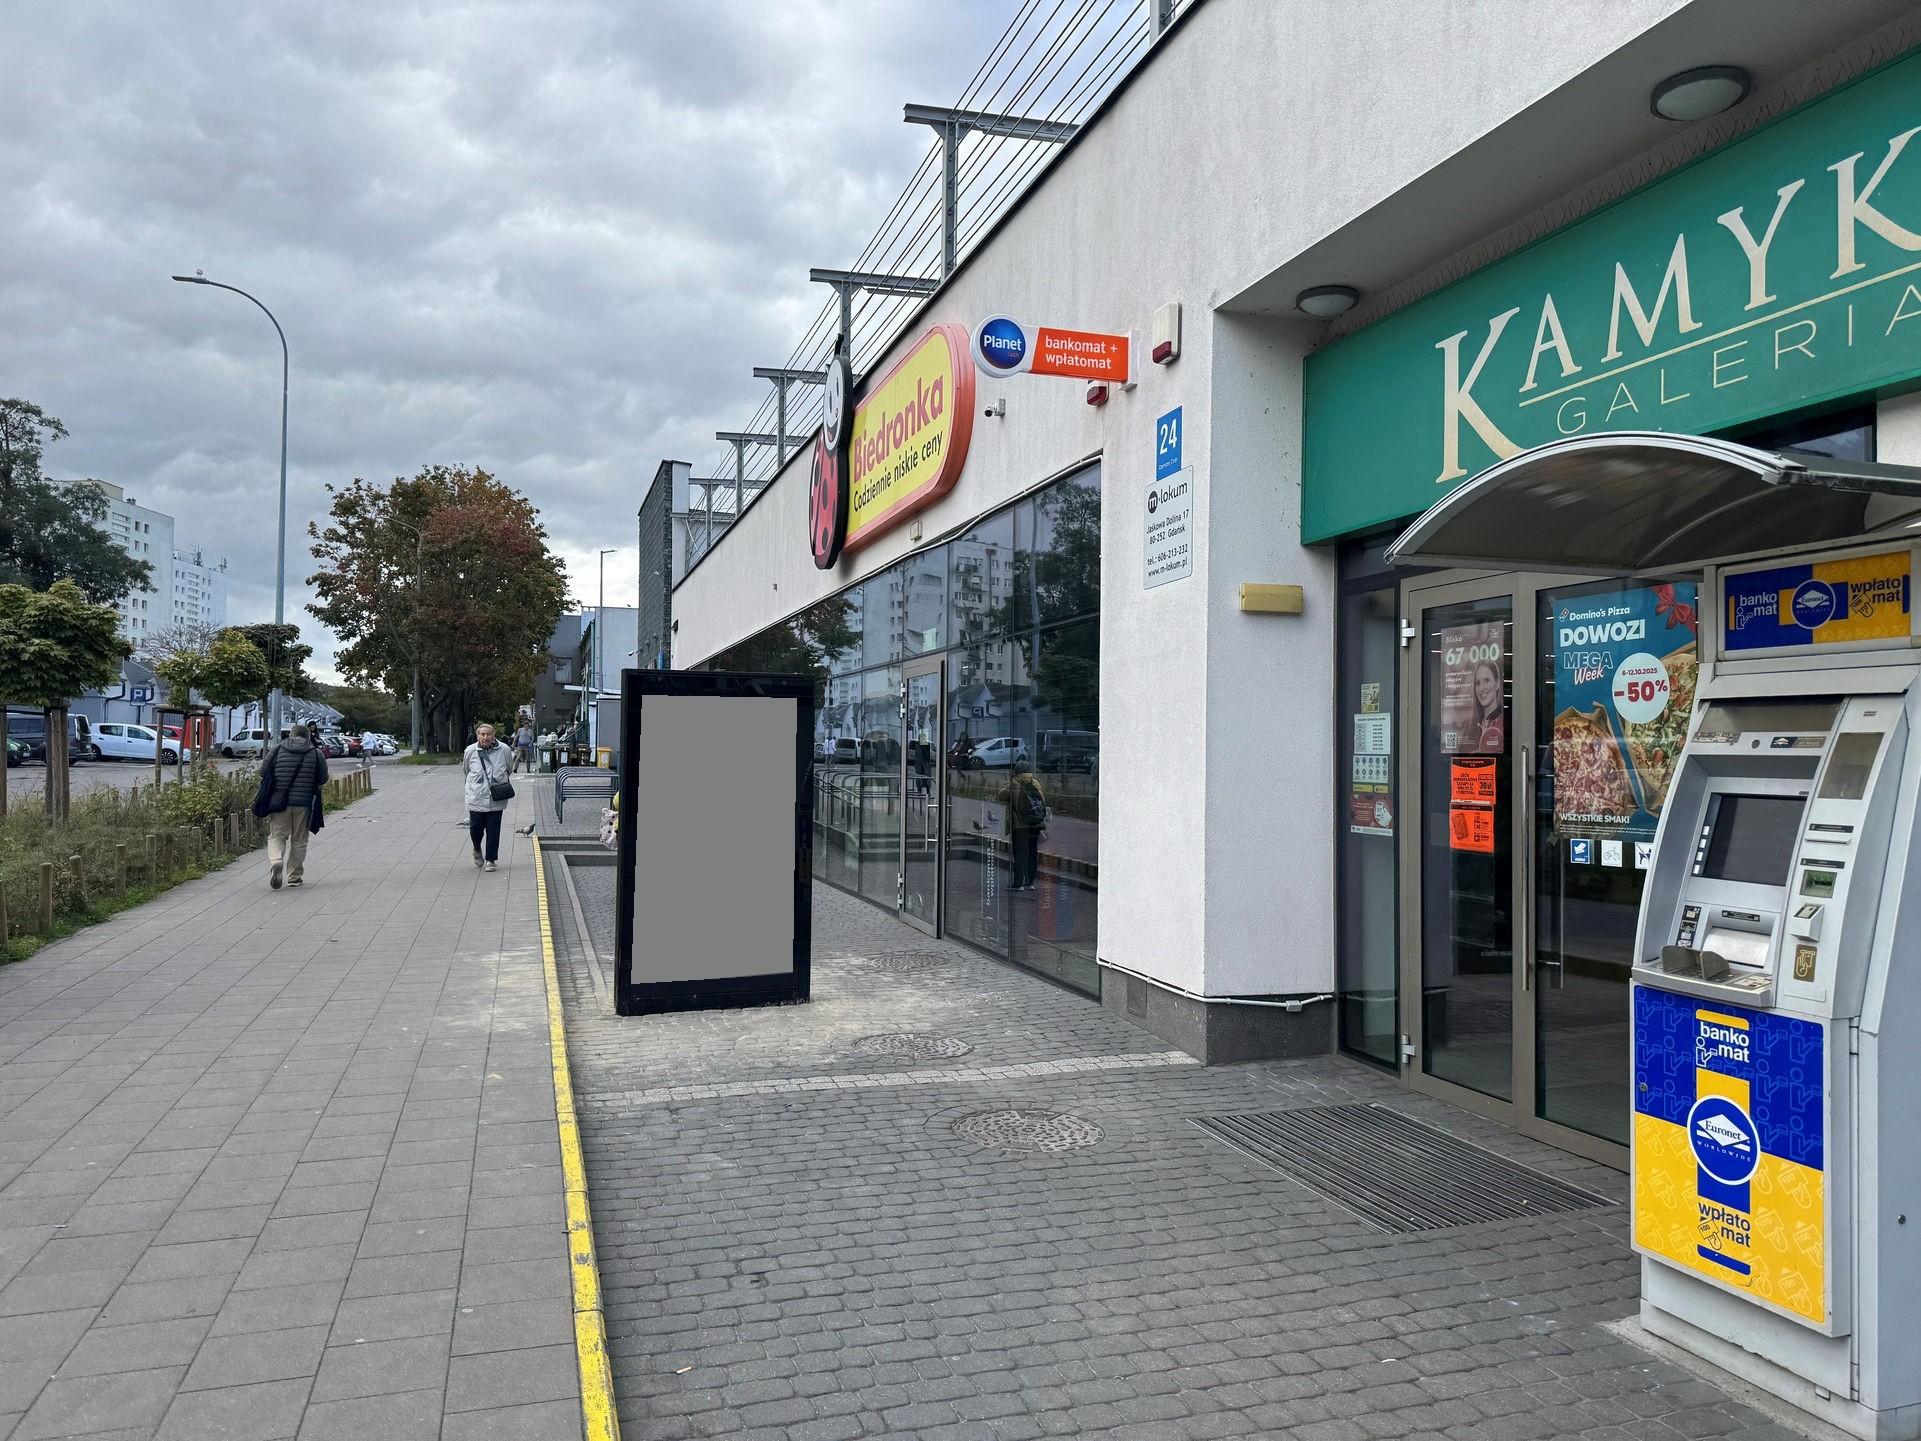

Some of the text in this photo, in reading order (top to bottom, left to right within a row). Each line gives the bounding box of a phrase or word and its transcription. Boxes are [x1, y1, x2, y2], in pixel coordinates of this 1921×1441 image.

[1434, 125, 1921, 485] KAMYK
[983, 334, 1022, 351] Planet
[1045, 335, 1118, 354] bankomat +
[1045, 353, 1112, 369] wpłatomat
[1556, 284, 1921, 435] GALERIA
[854, 374, 944, 484] Biedronka
[1160, 418, 1178, 456] 24
[853, 430, 943, 512] Codziennie niskie ceny
[1182, 508, 1190, 519] 17
[1149, 531, 1166, 545] 80-252
[1850, 577, 1901, 595] wpłato
[1740, 591, 1778, 607] banko
[1872, 589, 1901, 604] mat
[1569, 606, 1631, 622] Domino's Pizza
[1753, 602, 1778, 617] mat
[1560, 619, 1646, 648] DOWOZI
[1445, 643, 1500, 666] 67 000
[1563, 651, 1614, 669] MEGA
[1574, 662, 1605, 686] Week
[1622, 667, 1658, 676] 6-12.10.2025
[1560, 812, 1630, 824] WSZYSTKIE SMAKI
[1700, 1020, 1750, 1047] banko
[1718, 1044, 1750, 1063] mat
[1705, 1120, 1742, 1141] Euronet
[1696, 1140, 1751, 1162] WORLDWIDE
[1698, 1201, 1751, 1232] wpłato
[1721, 1225, 1751, 1248] mat
